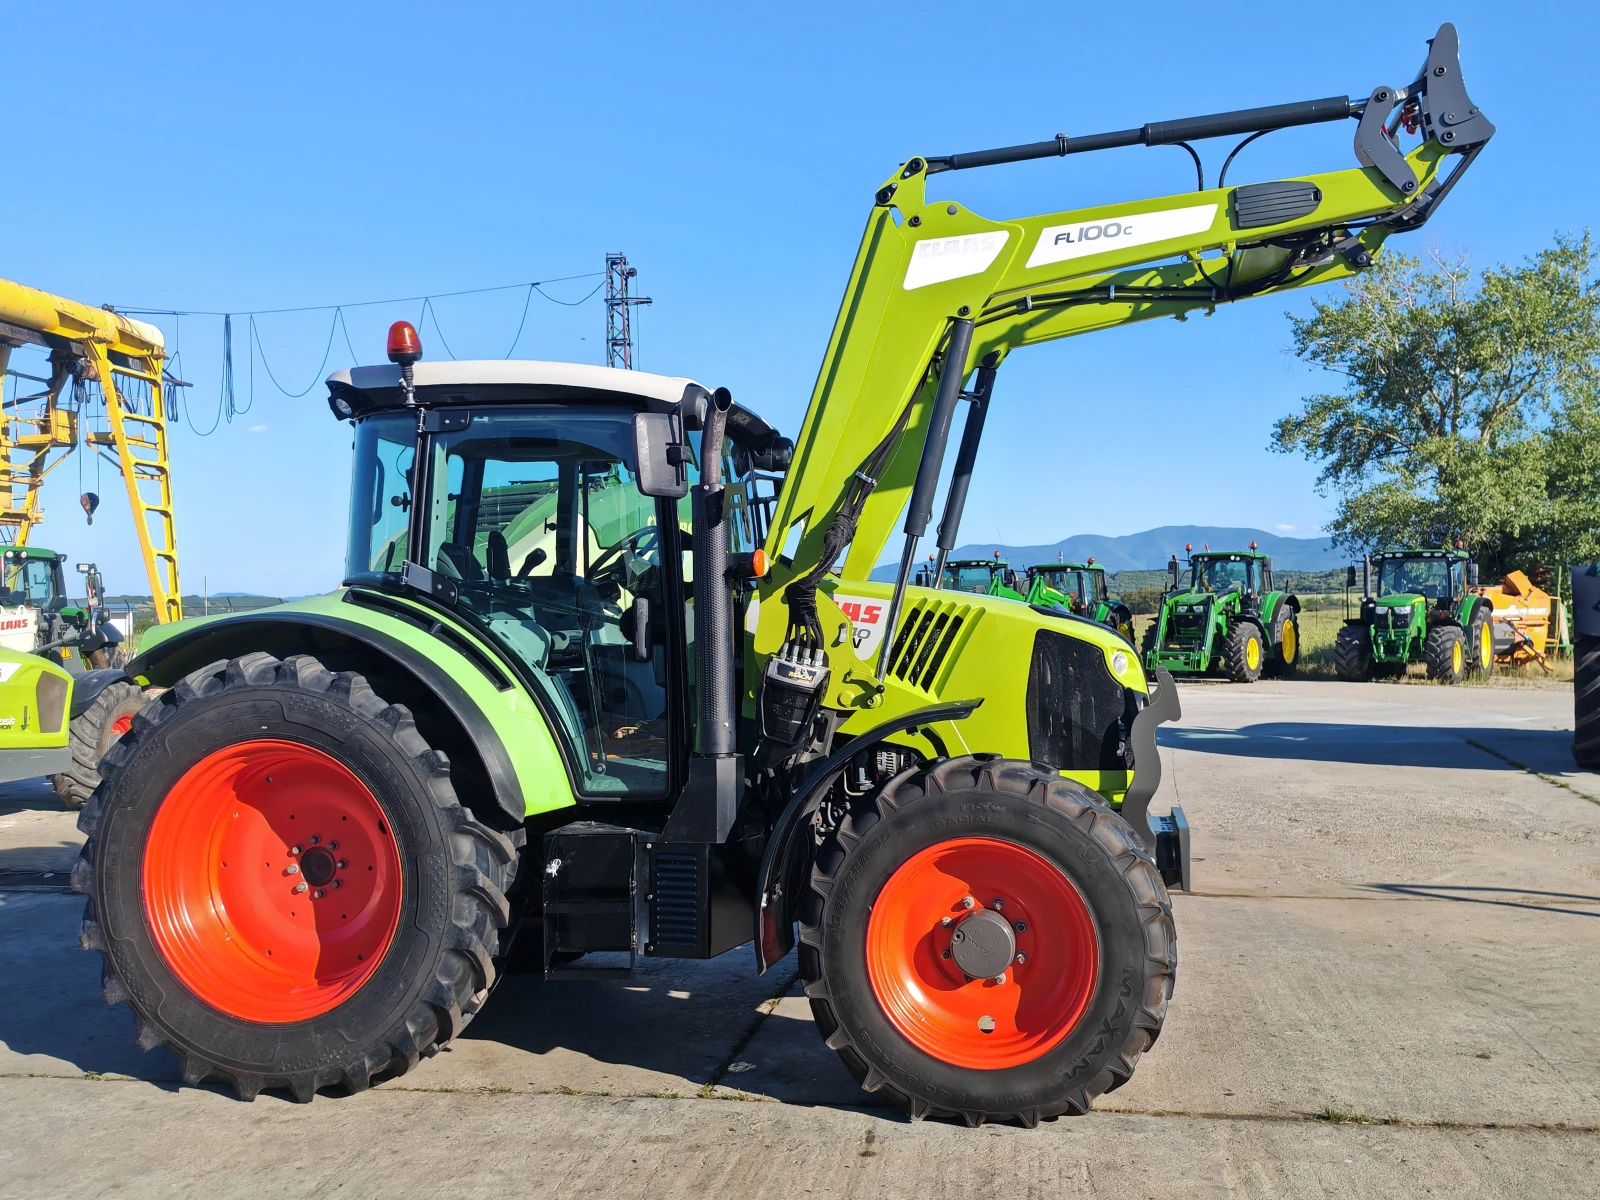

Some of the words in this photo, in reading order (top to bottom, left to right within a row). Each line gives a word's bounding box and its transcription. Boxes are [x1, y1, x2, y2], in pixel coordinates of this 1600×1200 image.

[918, 235, 996, 259] CLAAS
[0, 618, 29, 631] LAAS
[1063, 967, 1135, 1081] MAXAM
